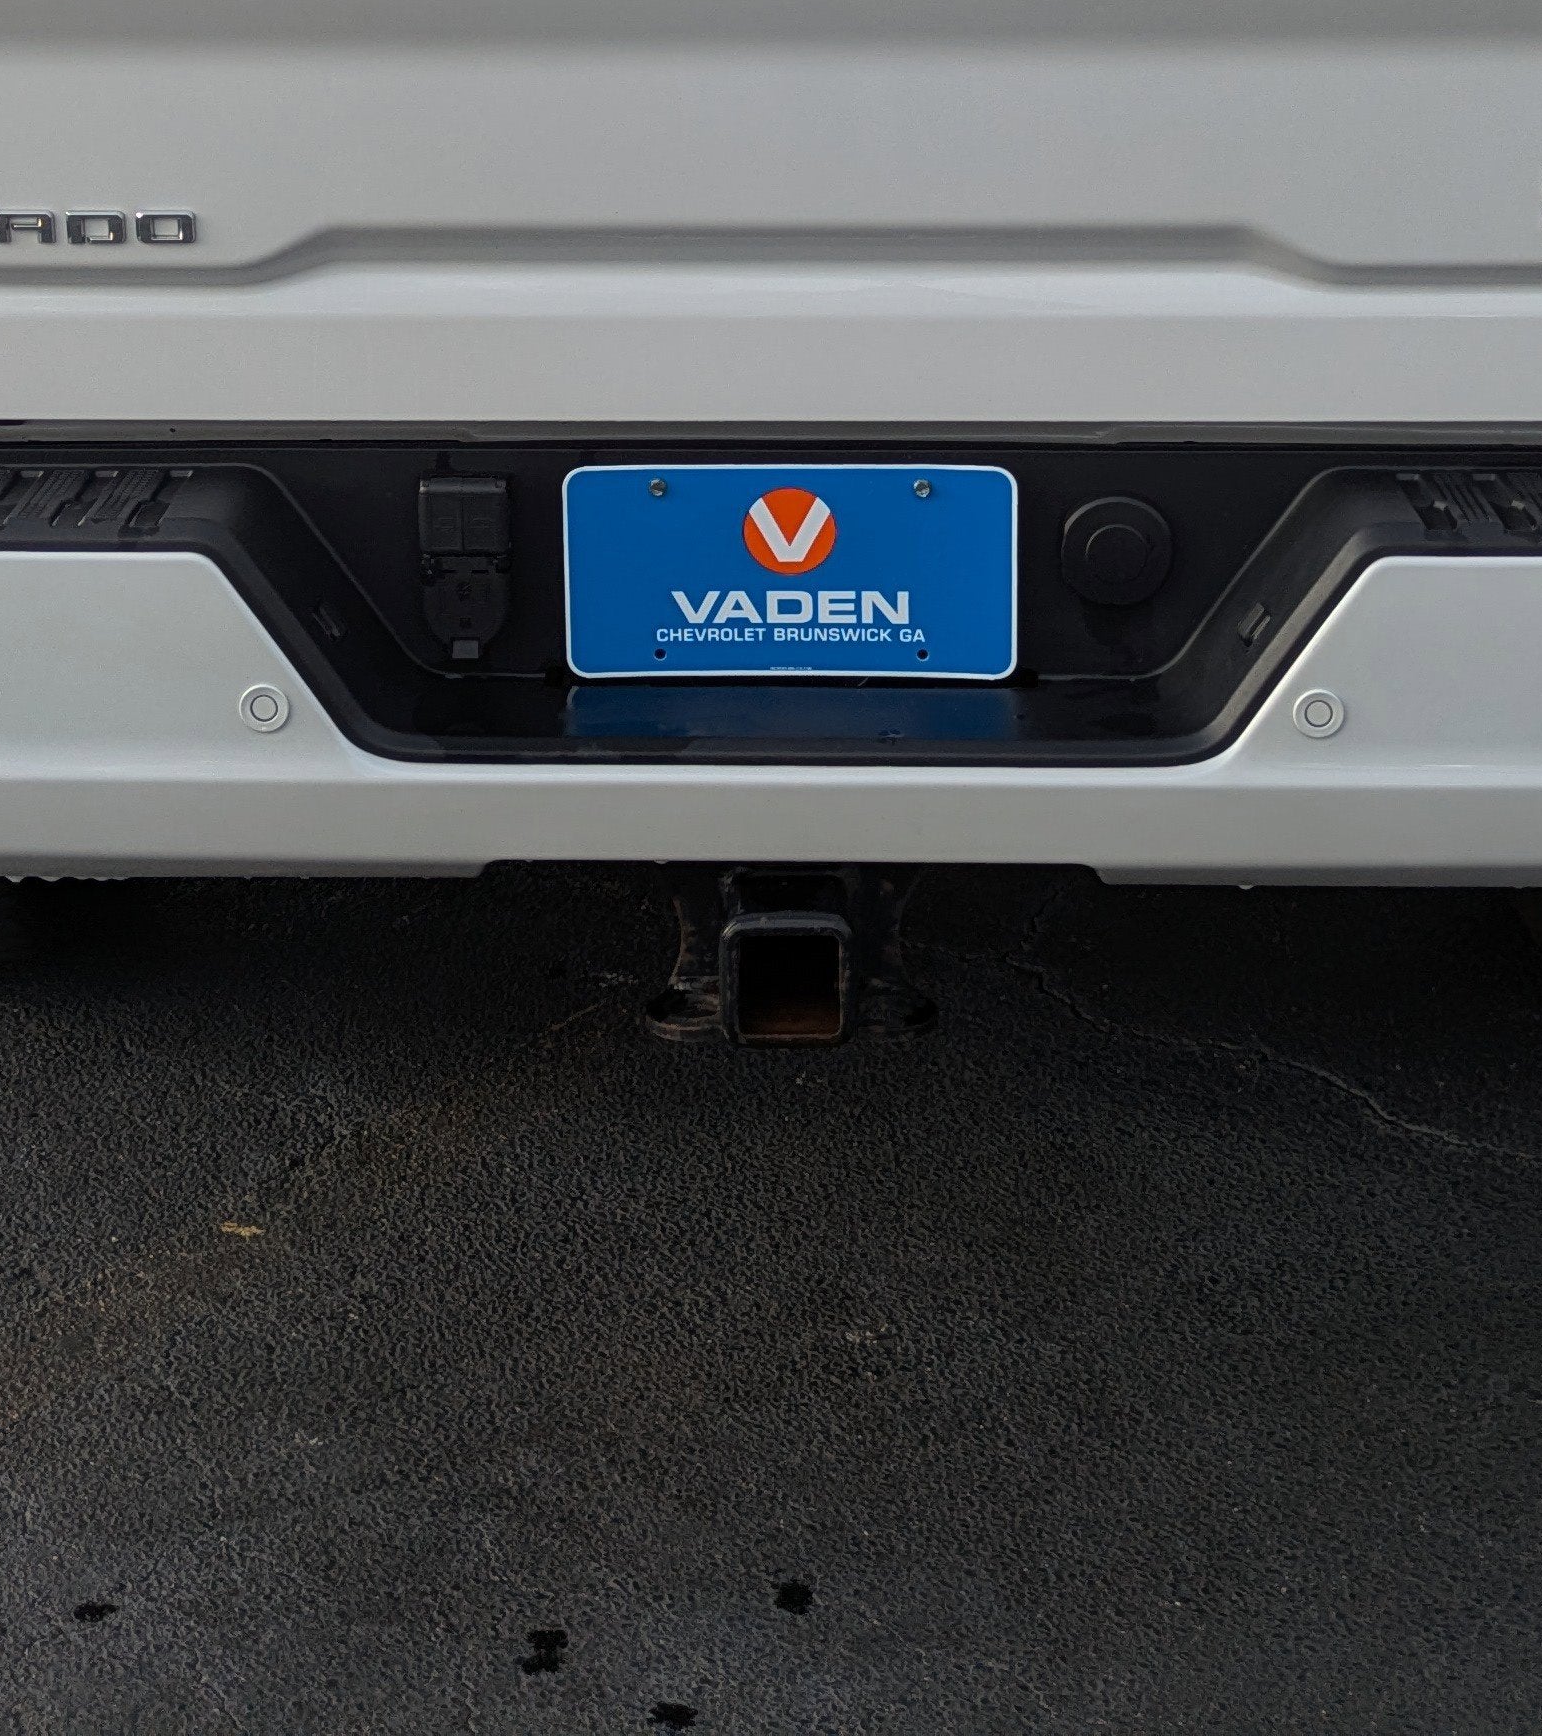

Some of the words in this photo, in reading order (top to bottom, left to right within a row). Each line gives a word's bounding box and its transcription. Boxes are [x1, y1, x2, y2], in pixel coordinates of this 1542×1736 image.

[671, 590, 910, 625] VADEN
[656, 627, 767, 643] CHEVROLET
[773, 627, 892, 643] BRUNSWICK
[899, 628, 926, 644] GA
